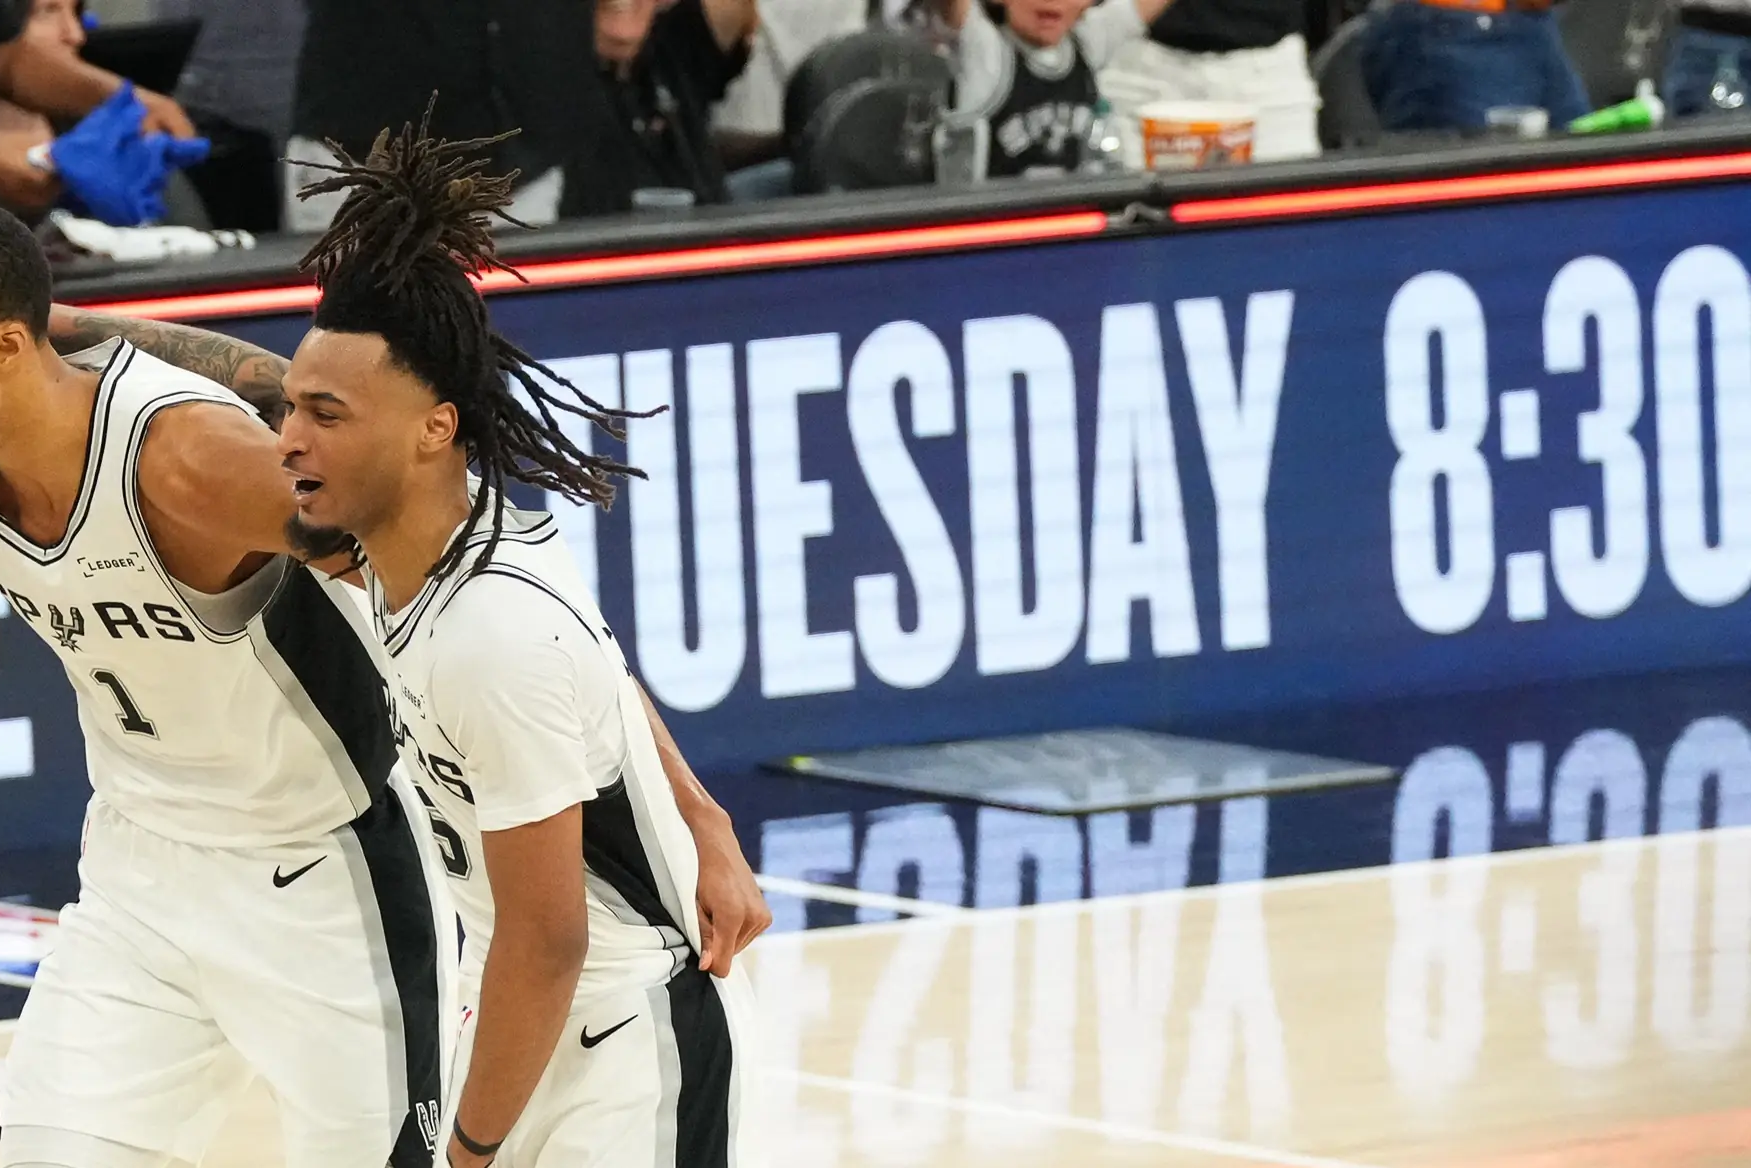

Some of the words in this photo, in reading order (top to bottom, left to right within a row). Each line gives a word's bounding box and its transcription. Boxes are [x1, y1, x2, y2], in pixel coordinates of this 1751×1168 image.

[1383, 244, 1751, 635] 8:30
[88, 557, 136, 572] LEDGER
[89, 667, 160, 741] 1
